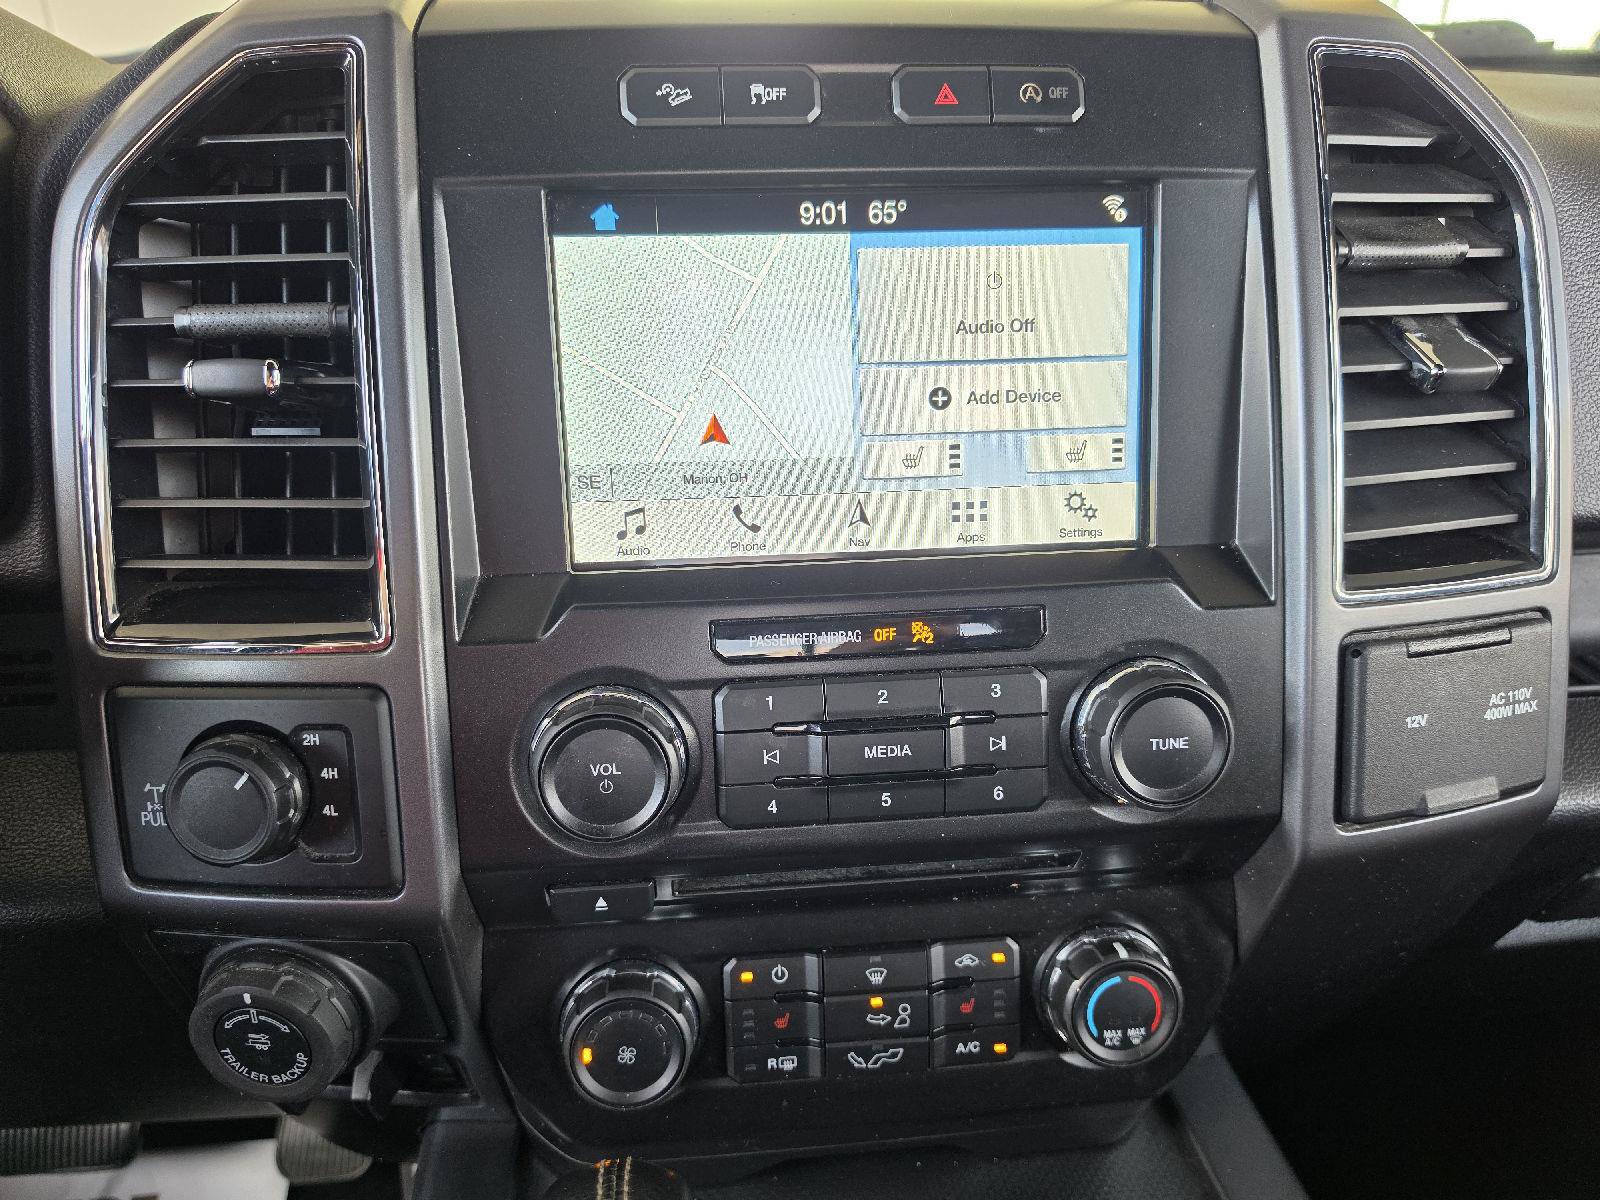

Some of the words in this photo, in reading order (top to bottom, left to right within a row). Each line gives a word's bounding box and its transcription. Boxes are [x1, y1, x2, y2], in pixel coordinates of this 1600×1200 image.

[764, 87, 787, 101] OFF
[1049, 87, 1069, 99] OFF
[799, 200, 848, 225] 9:01
[868, 199, 907, 225] 65°
[955, 319, 1005, 335] Audio
[1009, 317, 1036, 334] Off
[966, 390, 1000, 405] Add
[1005, 388, 1062, 404] Device
[577, 475, 602, 490] SE
[729, 472, 749, 484] OH
[956, 532, 986, 544] Apps
[1058, 527, 1103, 540] Settings
[729, 541, 767, 553] Phone
[849, 537, 871, 547] Nav
[616, 545, 651, 557] Audio
[749, 632, 818, 648] PASSENGER
[818, 630, 862, 644] AIRBAG
[873, 627, 897, 642] OFF
[877, 689, 888, 704] 2
[990, 684, 1001, 698] 3
[1488, 692, 1505, 707] AC
[1507, 687, 1533, 703] 110V
[765, 695, 773, 710] 1
[1483, 706, 1514, 721] 400W
[1514, 700, 1538, 716] MAX
[1405, 713, 1428, 729] 12V
[302, 733, 320, 746] 2H
[1149, 737, 1189, 751] TUNE
[864, 744, 912, 759] MEDIA
[320, 767, 339, 780] 4H
[589, 763, 622, 776] VOL
[881, 792, 892, 807] 5
[993, 785, 1004, 800] 6
[322, 804, 339, 817] 4L
[767, 799, 778, 814] 4
[140, 811, 168, 827] PUL
[1103, 1029, 1123, 1039] MAX
[1127, 1026, 1147, 1038] MAX
[955, 1041, 981, 1055] A/C
[219, 1047, 270, 1083] TRAILER
[271, 1052, 309, 1084] BACKUP
[767, 1057, 777, 1070] R
